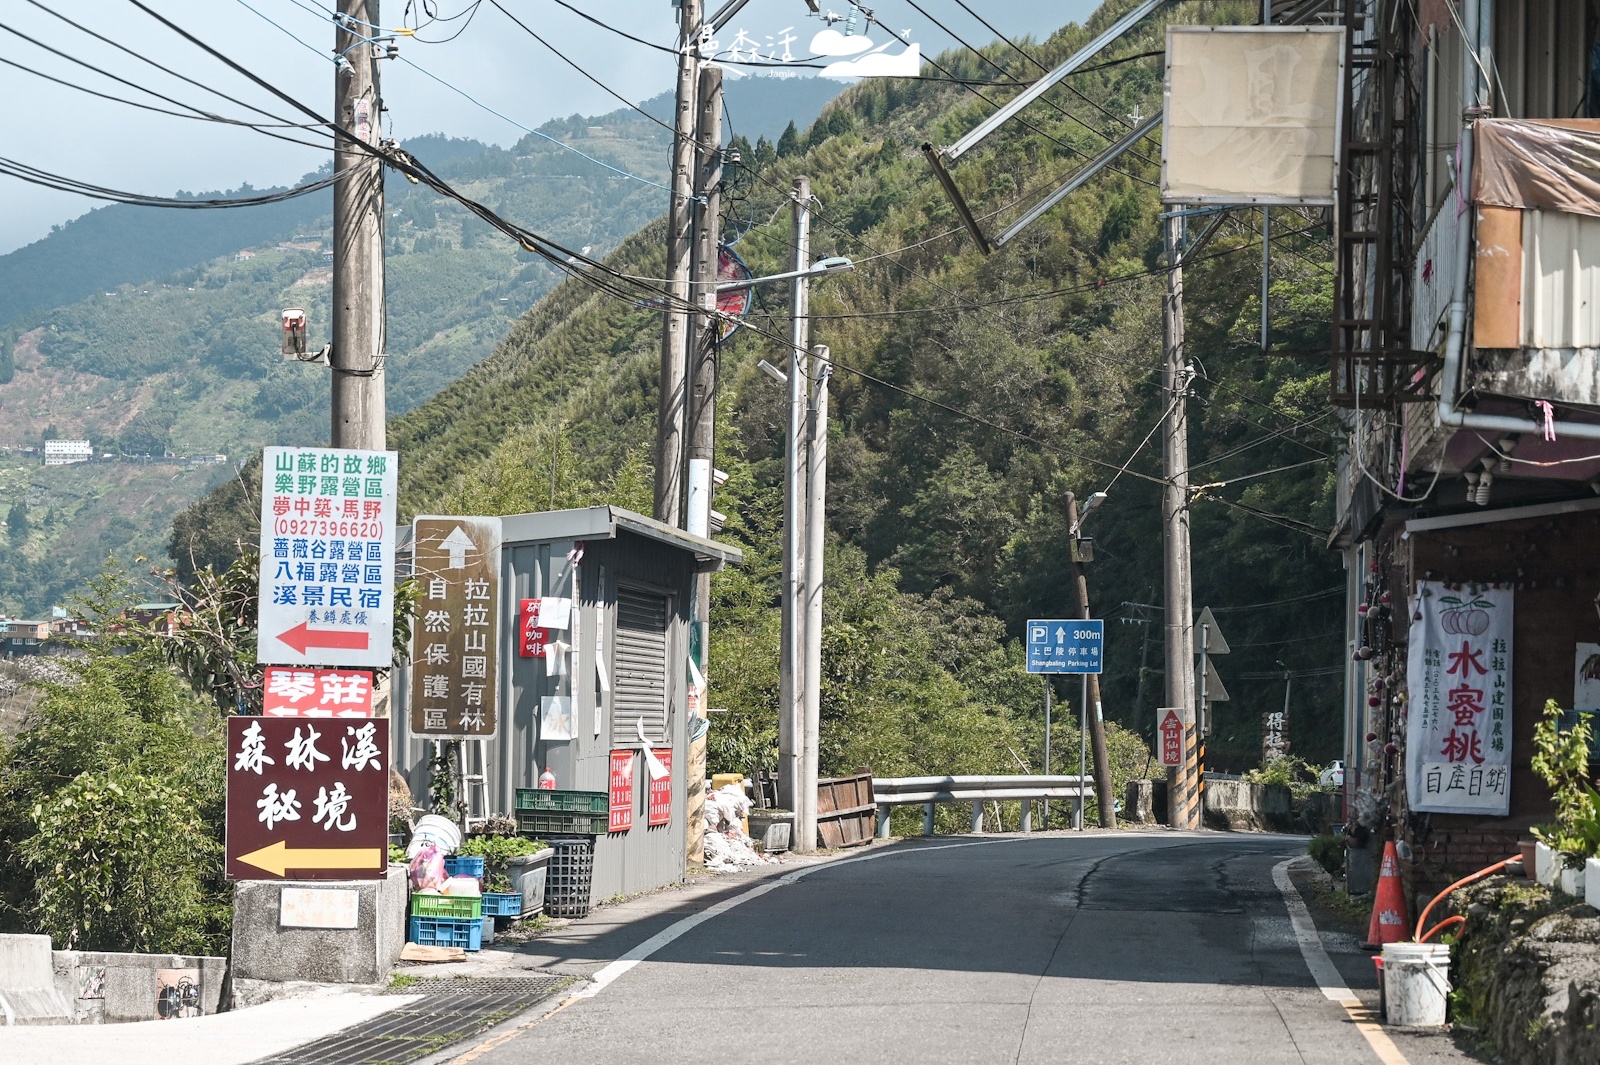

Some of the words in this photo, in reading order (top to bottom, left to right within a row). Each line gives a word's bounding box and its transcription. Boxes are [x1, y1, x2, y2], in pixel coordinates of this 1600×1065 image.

[275, 451, 387, 476] 山蘇的故鄉
[274, 473, 383, 498] 樂野露營區
[272, 496, 382, 520] 夢中築、馬野
[274, 517, 383, 540] (0927396620)
[273, 538, 382, 562] 薔薇谷露營區
[274, 561, 382, 584] 八福露營區
[273, 585, 382, 609] 溪景民宿
[1032, 627, 1046, 642] P
[1073, 630, 1100, 640] 300m
[422, 578, 451, 731] 自然保護區
[459, 577, 490, 732] 拉拉山國有林
[1031, 659, 1066, 667] Shangbaling
[1032, 646, 1099, 656] 上巴陵停車場
[267, 670, 369, 705] 琴莊
[1441, 640, 1489, 765] 水蜜桃
[233, 720, 382, 775] 森林溪
[1164, 718, 1179, 762] 雲山仙境
[1426, 763, 1507, 796] 自產自銷
[256, 781, 357, 832] 秘境
